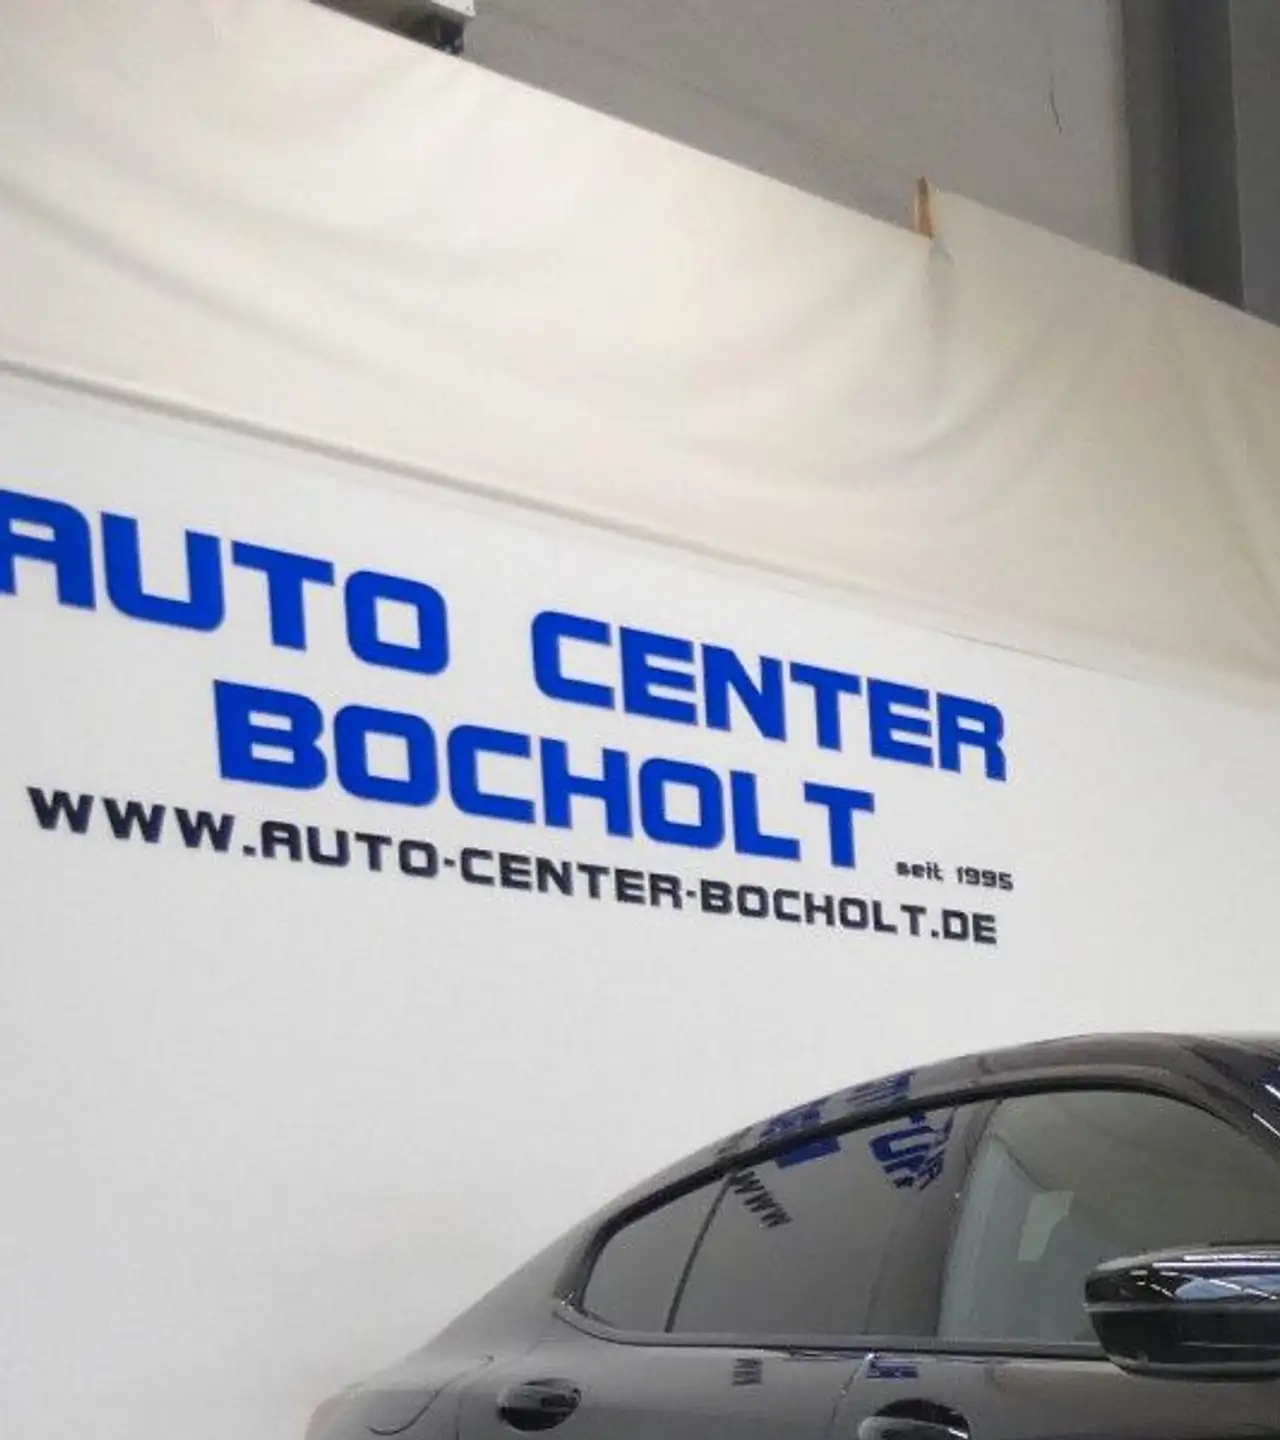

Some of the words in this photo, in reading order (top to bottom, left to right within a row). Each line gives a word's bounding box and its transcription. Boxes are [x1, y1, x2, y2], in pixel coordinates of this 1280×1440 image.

[0, 488, 452, 678] AUTO
[529, 609, 1009, 782] CENTER
[212, 679, 876, 870] BOCHOLT
[26, 786, 998, 945] WWW.AUTO-CENTER-BOCHOLT.DE
[895, 860, 945, 882] seit
[956, 866, 1014, 892] 1995
